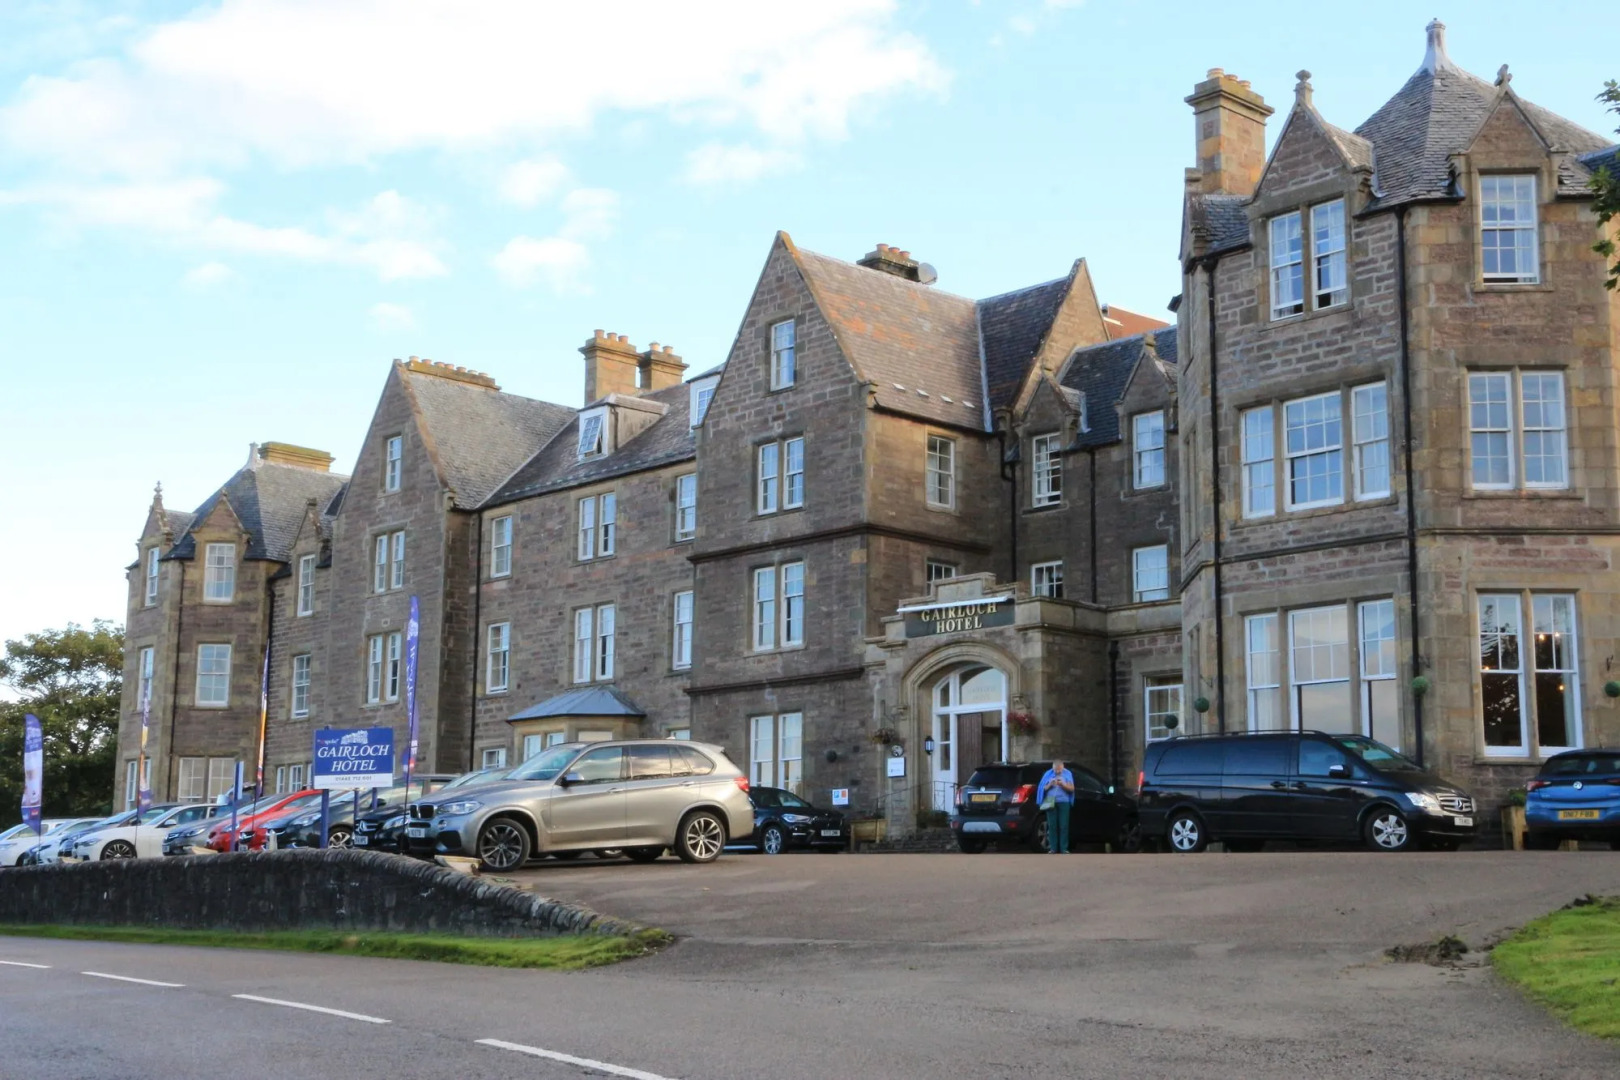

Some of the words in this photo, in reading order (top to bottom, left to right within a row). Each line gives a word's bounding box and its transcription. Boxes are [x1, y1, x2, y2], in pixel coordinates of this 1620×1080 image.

[921, 603, 997, 622] GAIRLOCH
[936, 616, 982, 634] HOTEL
[317, 744, 390, 760] GAIRLOCH
[331, 759, 377, 772] HOTEL
